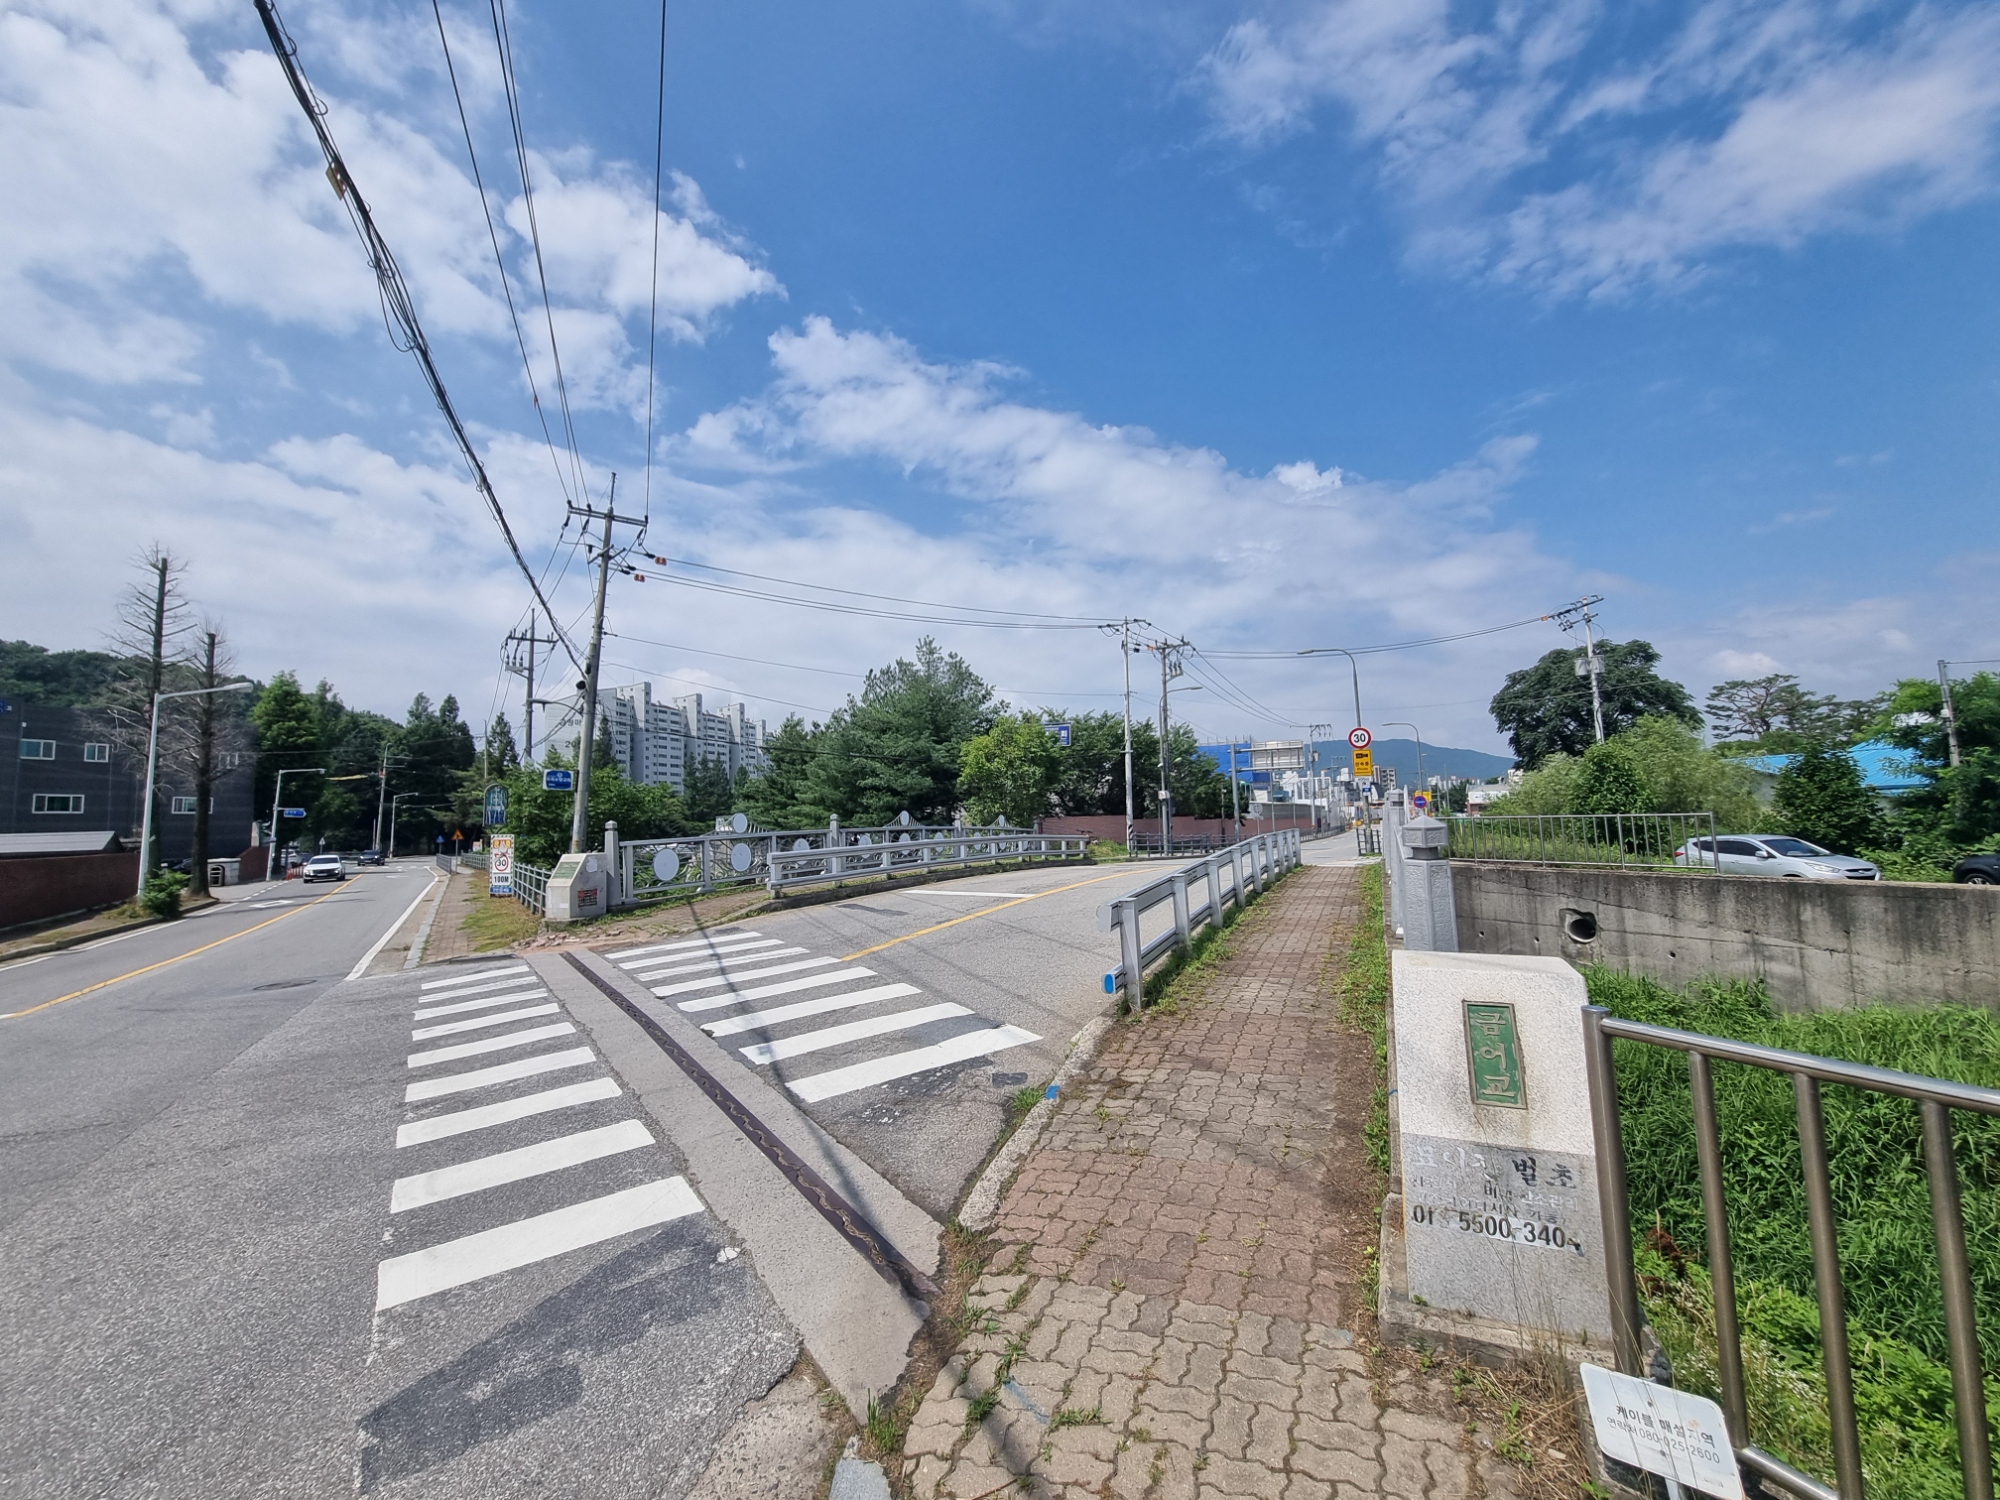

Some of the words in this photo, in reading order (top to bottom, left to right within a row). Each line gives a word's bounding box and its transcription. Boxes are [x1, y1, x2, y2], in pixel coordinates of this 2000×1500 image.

[1353, 733, 1366, 743] 30
[497, 859, 507, 867] 30
[494, 875, 509, 883] 100M
[1474, 1012, 1515, 1098] 금오교
[1615, 1405, 1655, 1429] 케이블
